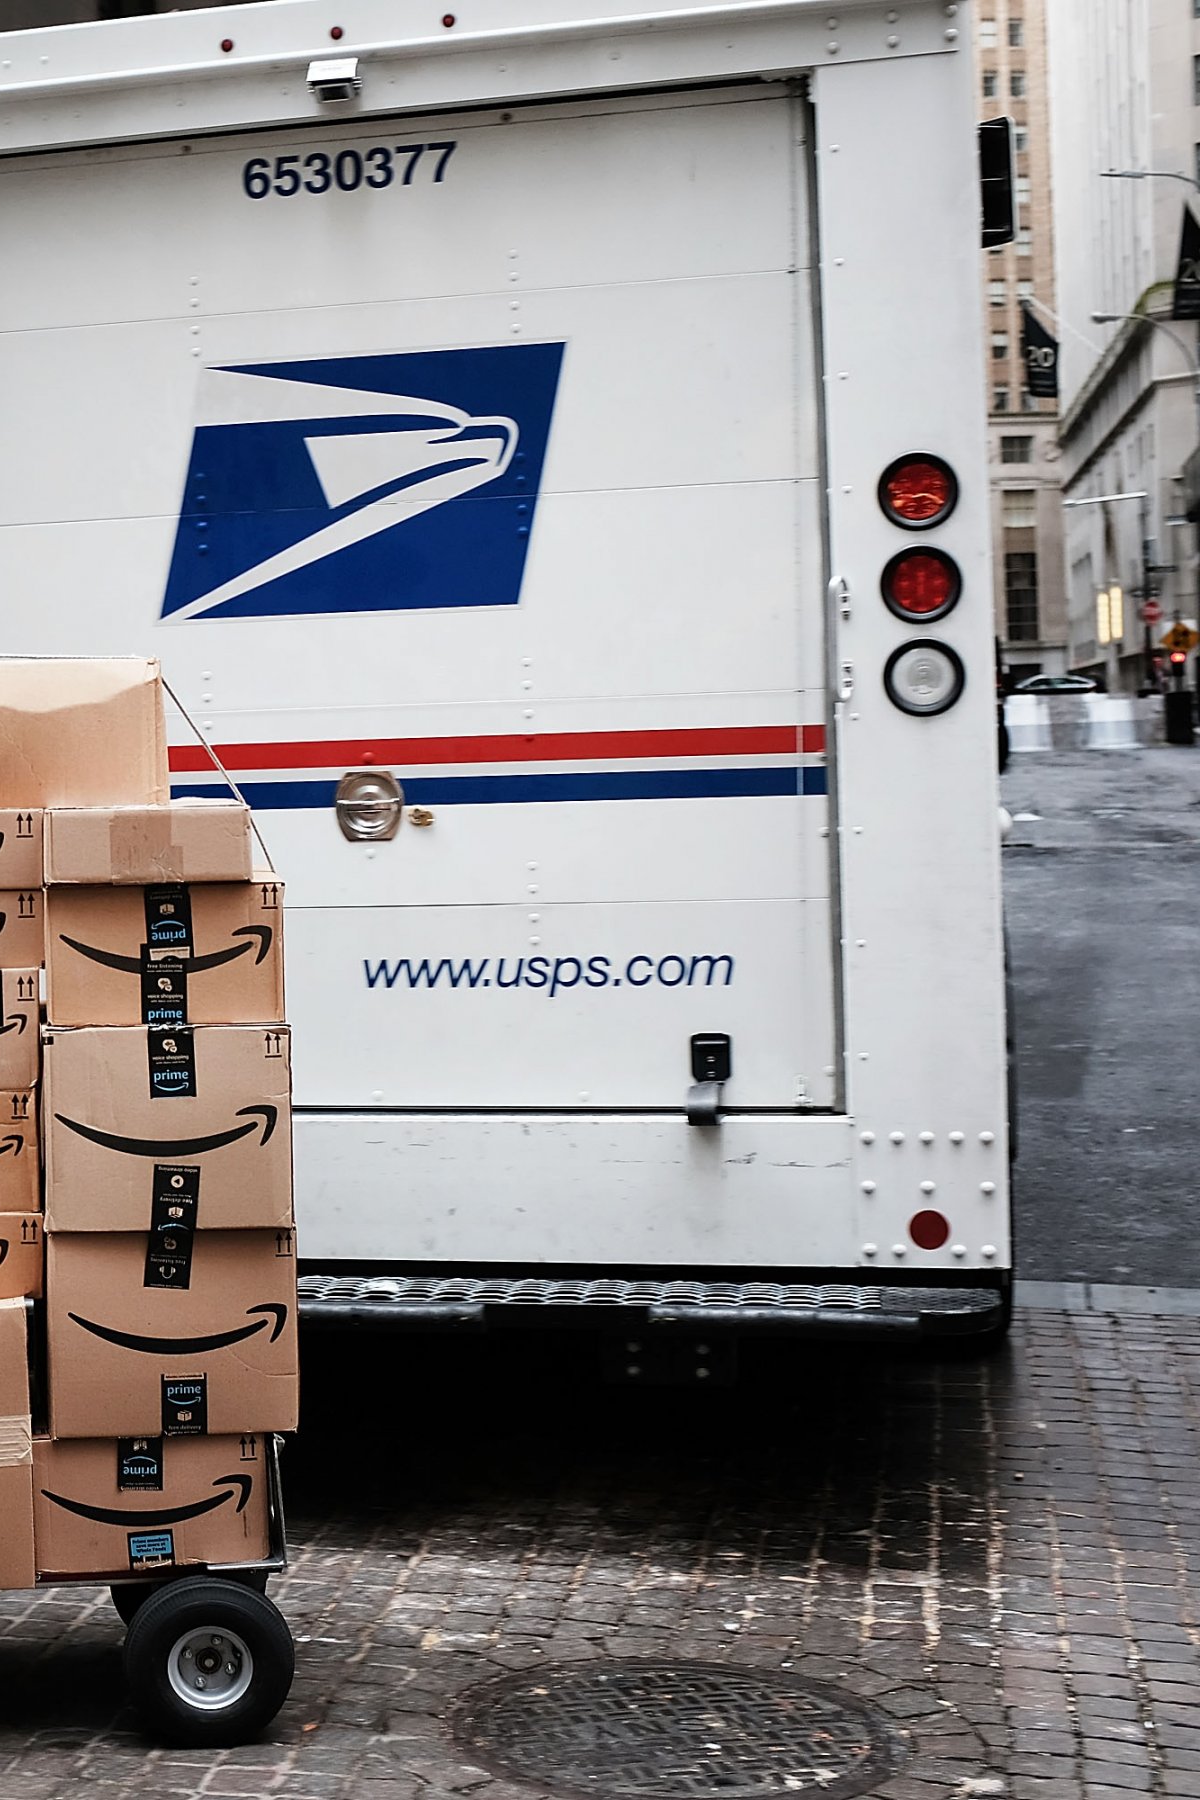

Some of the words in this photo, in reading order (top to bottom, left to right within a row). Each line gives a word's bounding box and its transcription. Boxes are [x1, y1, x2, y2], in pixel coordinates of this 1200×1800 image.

[242, 140, 457, 199] 6530377
[1026, 345, 1055, 367] 20
[151, 928, 186, 942] prime
[363, 954, 734, 998] www.usps.com
[148, 1008, 183, 1021] prime
[153, 1069, 189, 1083] prime
[167, 1383, 202, 1397] prime
[123, 1464, 157, 1477] prime
